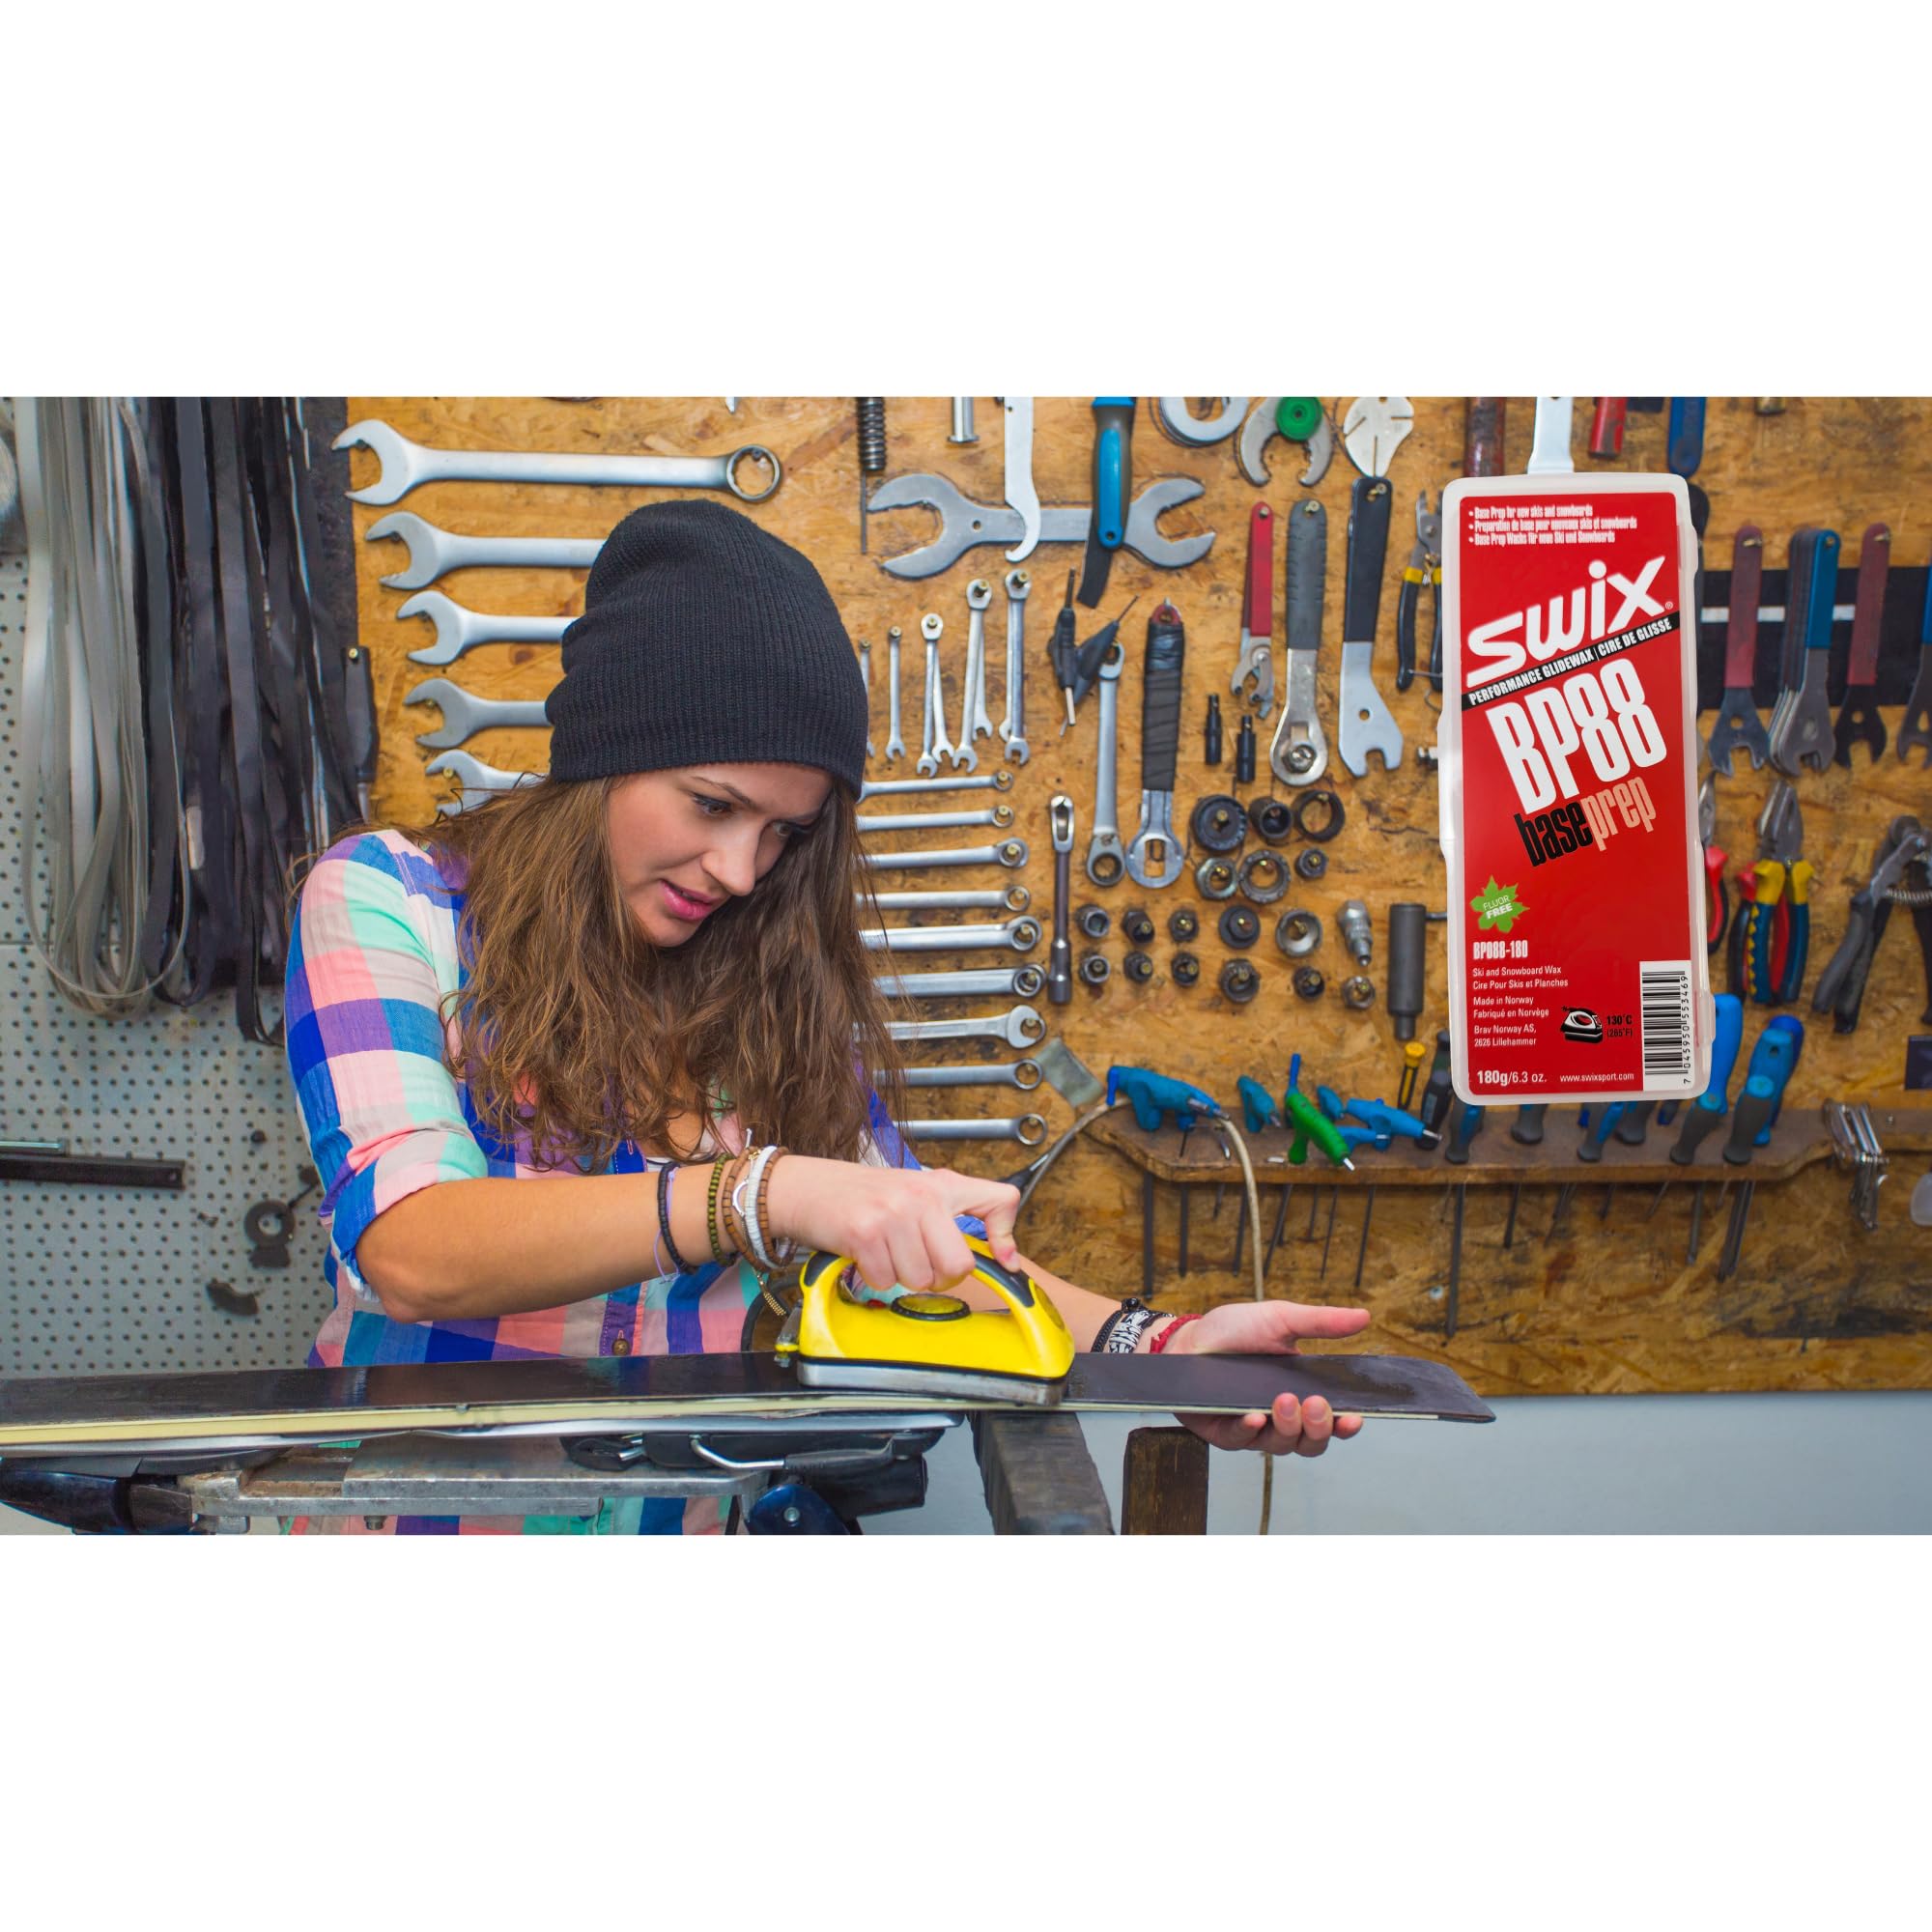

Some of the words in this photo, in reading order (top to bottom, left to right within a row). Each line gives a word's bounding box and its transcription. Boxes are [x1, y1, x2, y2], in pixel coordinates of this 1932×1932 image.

[1468, 668, 1544, 706] PERFORMANCE
[1542, 648, 1595, 678] GLIDEWAX
[1598, 637, 1623, 658] CIRE
[1623, 631, 1637, 647] DE
[1636, 617, 1672, 642] GLISSE
[1485, 658, 1667, 815] BP88
[1483, 895, 1511, 910] FLUOR
[1486, 902, 1513, 920] FREE
[1473, 940, 1528, 960] BP088-180
[1472, 967, 1484, 978] Ski
[1486, 967, 1499, 977] and
[1501, 966, 1544, 977] Snowboard
[1545, 965, 1562, 975] Wax
[1472, 980, 1488, 990] Cire
[1490, 980, 1507, 989] Pour
[1508, 979, 1523, 988] Skis
[1525, 980, 1533, 988] et
[1534, 978, 1569, 988] Planches
[1473, 996, 1494, 1006] Made
[1496, 996, 1503, 1005] in
[1505, 996, 1534, 1005] Norway
[1473, 1009, 1505, 1019] Fabriqué
[1518, 1008, 1549, 1018] Norvège
[1474, 1025, 1492, 1035] Brav
[1492, 1024, 1522, 1035] Norway
[1523, 1023, 1537, 1034] AS,
[1492, 1037, 1537, 1046] Lillehammer
[1477, 1069, 1528, 1087] 180g/6.3
[1531, 1073, 1547, 1083] oz.
[1560, 1072, 1634, 1083] www.swixsport.com
